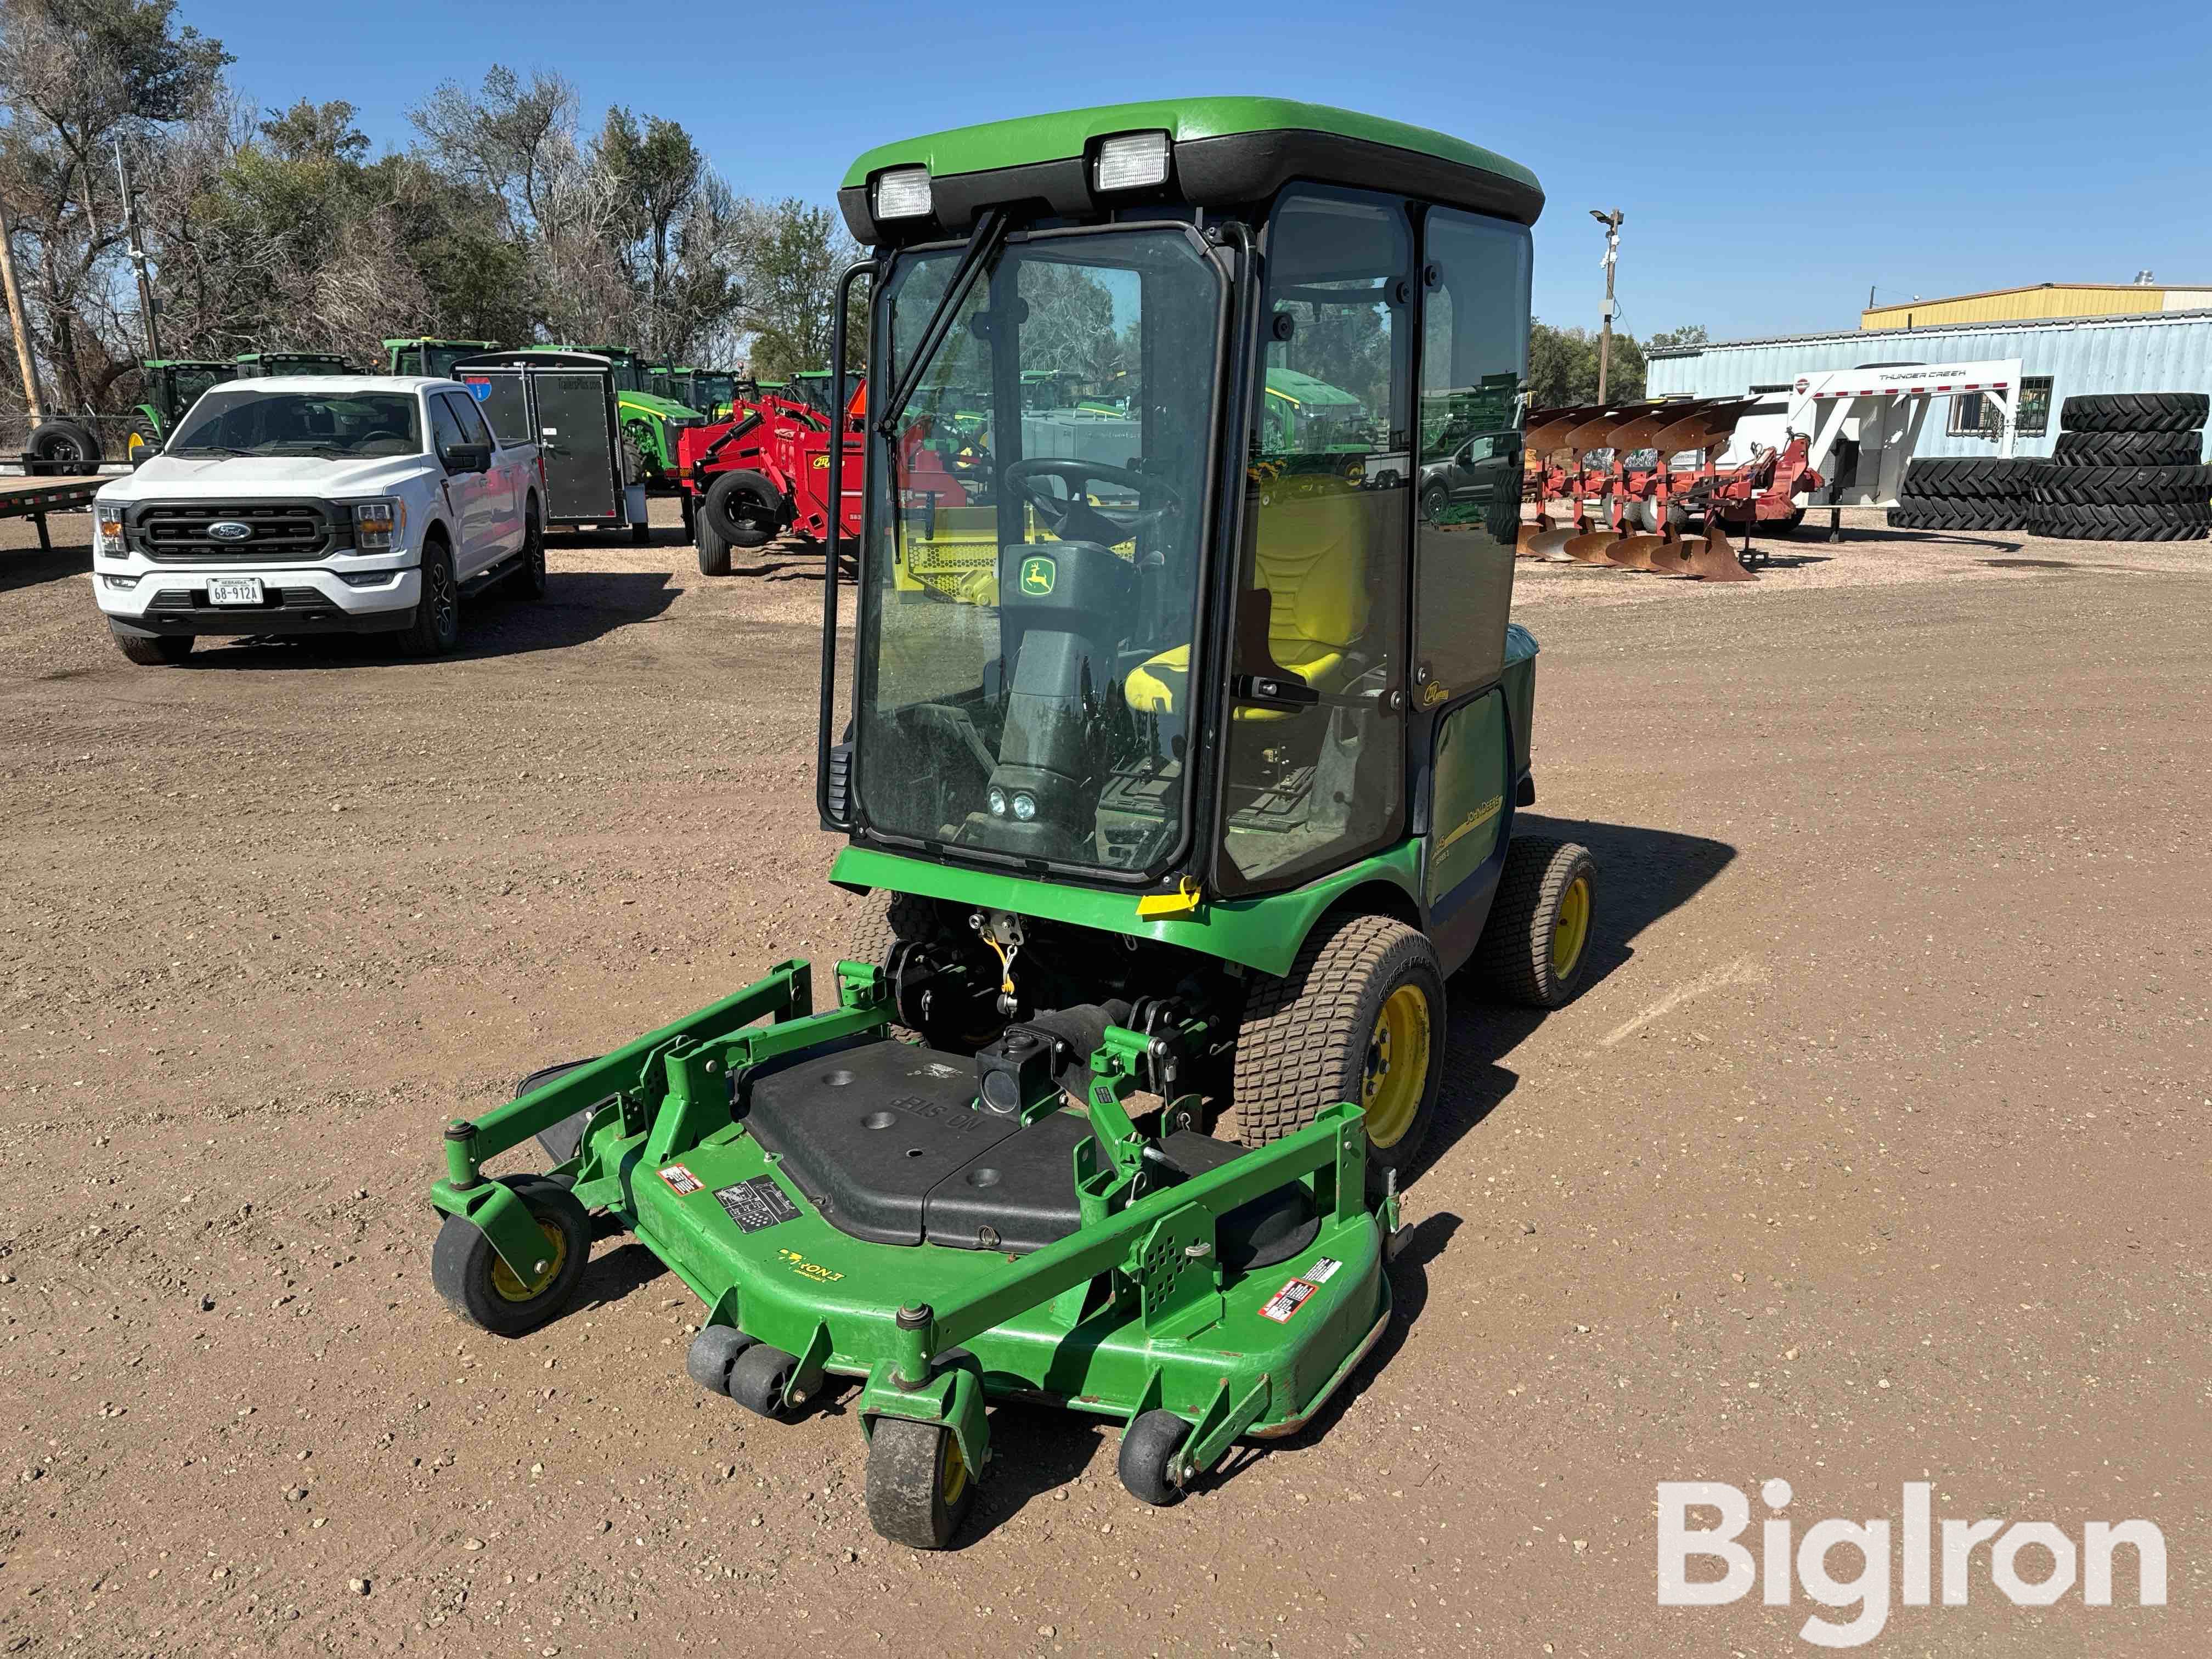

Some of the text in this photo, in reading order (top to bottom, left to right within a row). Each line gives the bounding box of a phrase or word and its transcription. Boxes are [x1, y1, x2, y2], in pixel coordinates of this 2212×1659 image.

[219, 526, 241, 536] Ford
[215, 587, 257, 600] 68-912A
[1466, 794, 1499, 825] JOHN DEERE
[890, 1095, 986, 1132] NO STEP
